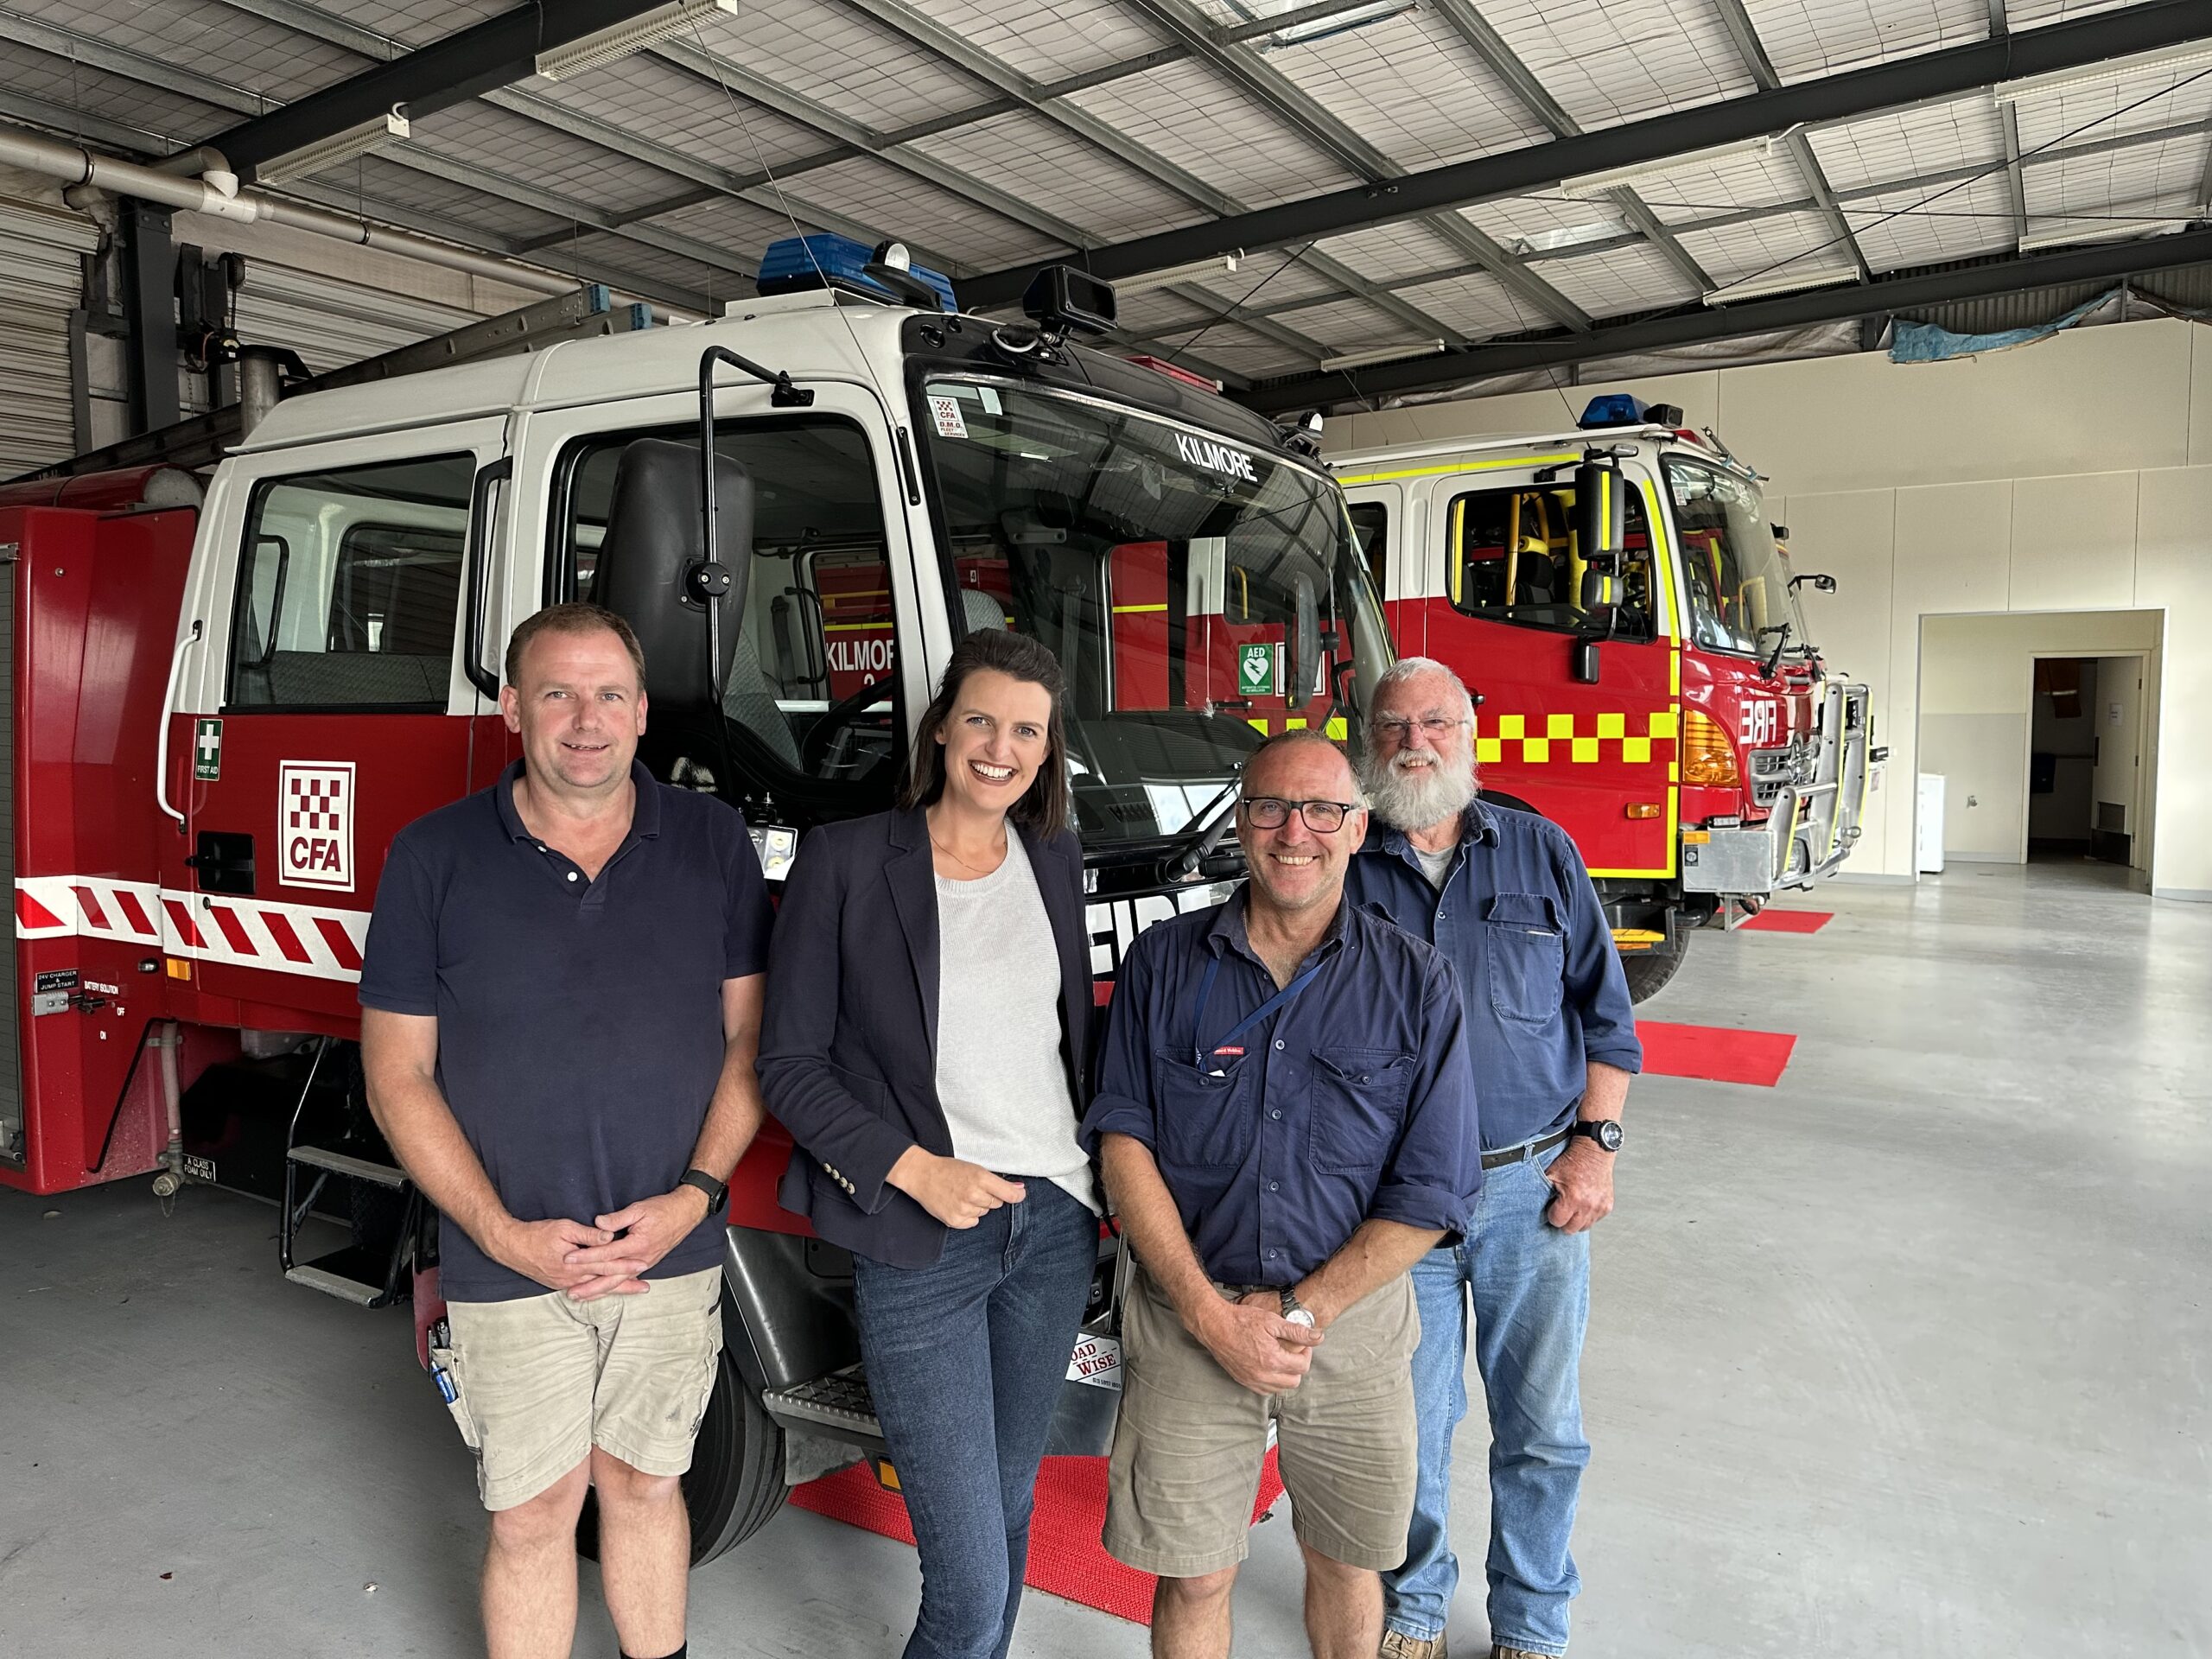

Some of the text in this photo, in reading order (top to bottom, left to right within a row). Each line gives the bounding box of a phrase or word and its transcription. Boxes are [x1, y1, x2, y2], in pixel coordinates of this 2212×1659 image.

[1175, 433, 1258, 482] KILMORE
[826, 639, 893, 671] KILMO
[1247, 647, 1266, 658] AED
[197, 765, 219, 775] FIRST AID
[290, 836, 341, 872] CFA
[49, 970, 77, 979] CHARGER
[117, 1007, 125, 1017] OFF
[99, 1031, 107, 1040] ON
[193, 1158, 208, 1170] CLASS
[184, 1164, 213, 1179] FOAM ONLY
[1071, 1343, 1096, 1361] OAD
[1077, 1353, 1116, 1376] WISE
